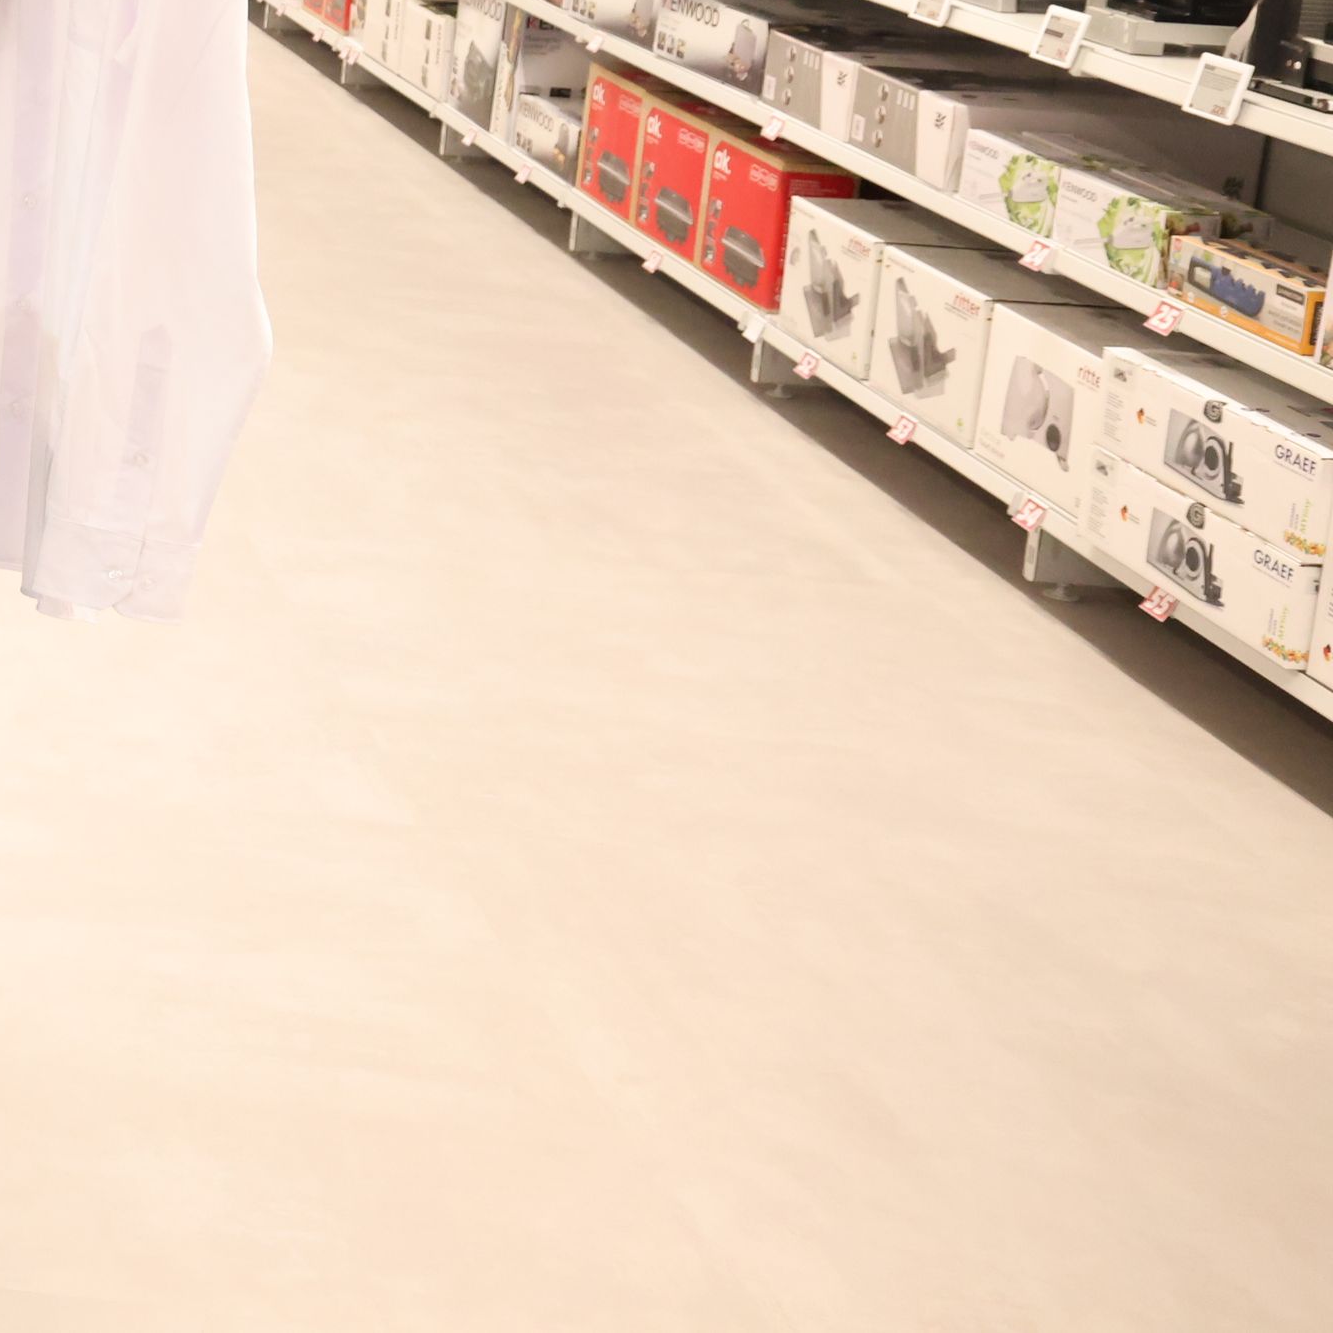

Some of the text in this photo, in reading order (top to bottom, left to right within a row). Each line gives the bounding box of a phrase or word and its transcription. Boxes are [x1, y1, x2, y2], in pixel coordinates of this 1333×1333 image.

[953, 291, 981, 316] ritter
[1151, 304, 1179, 334] 25
[1078, 366, 1101, 389] ritte
[1144, 592, 1174, 617] 55
